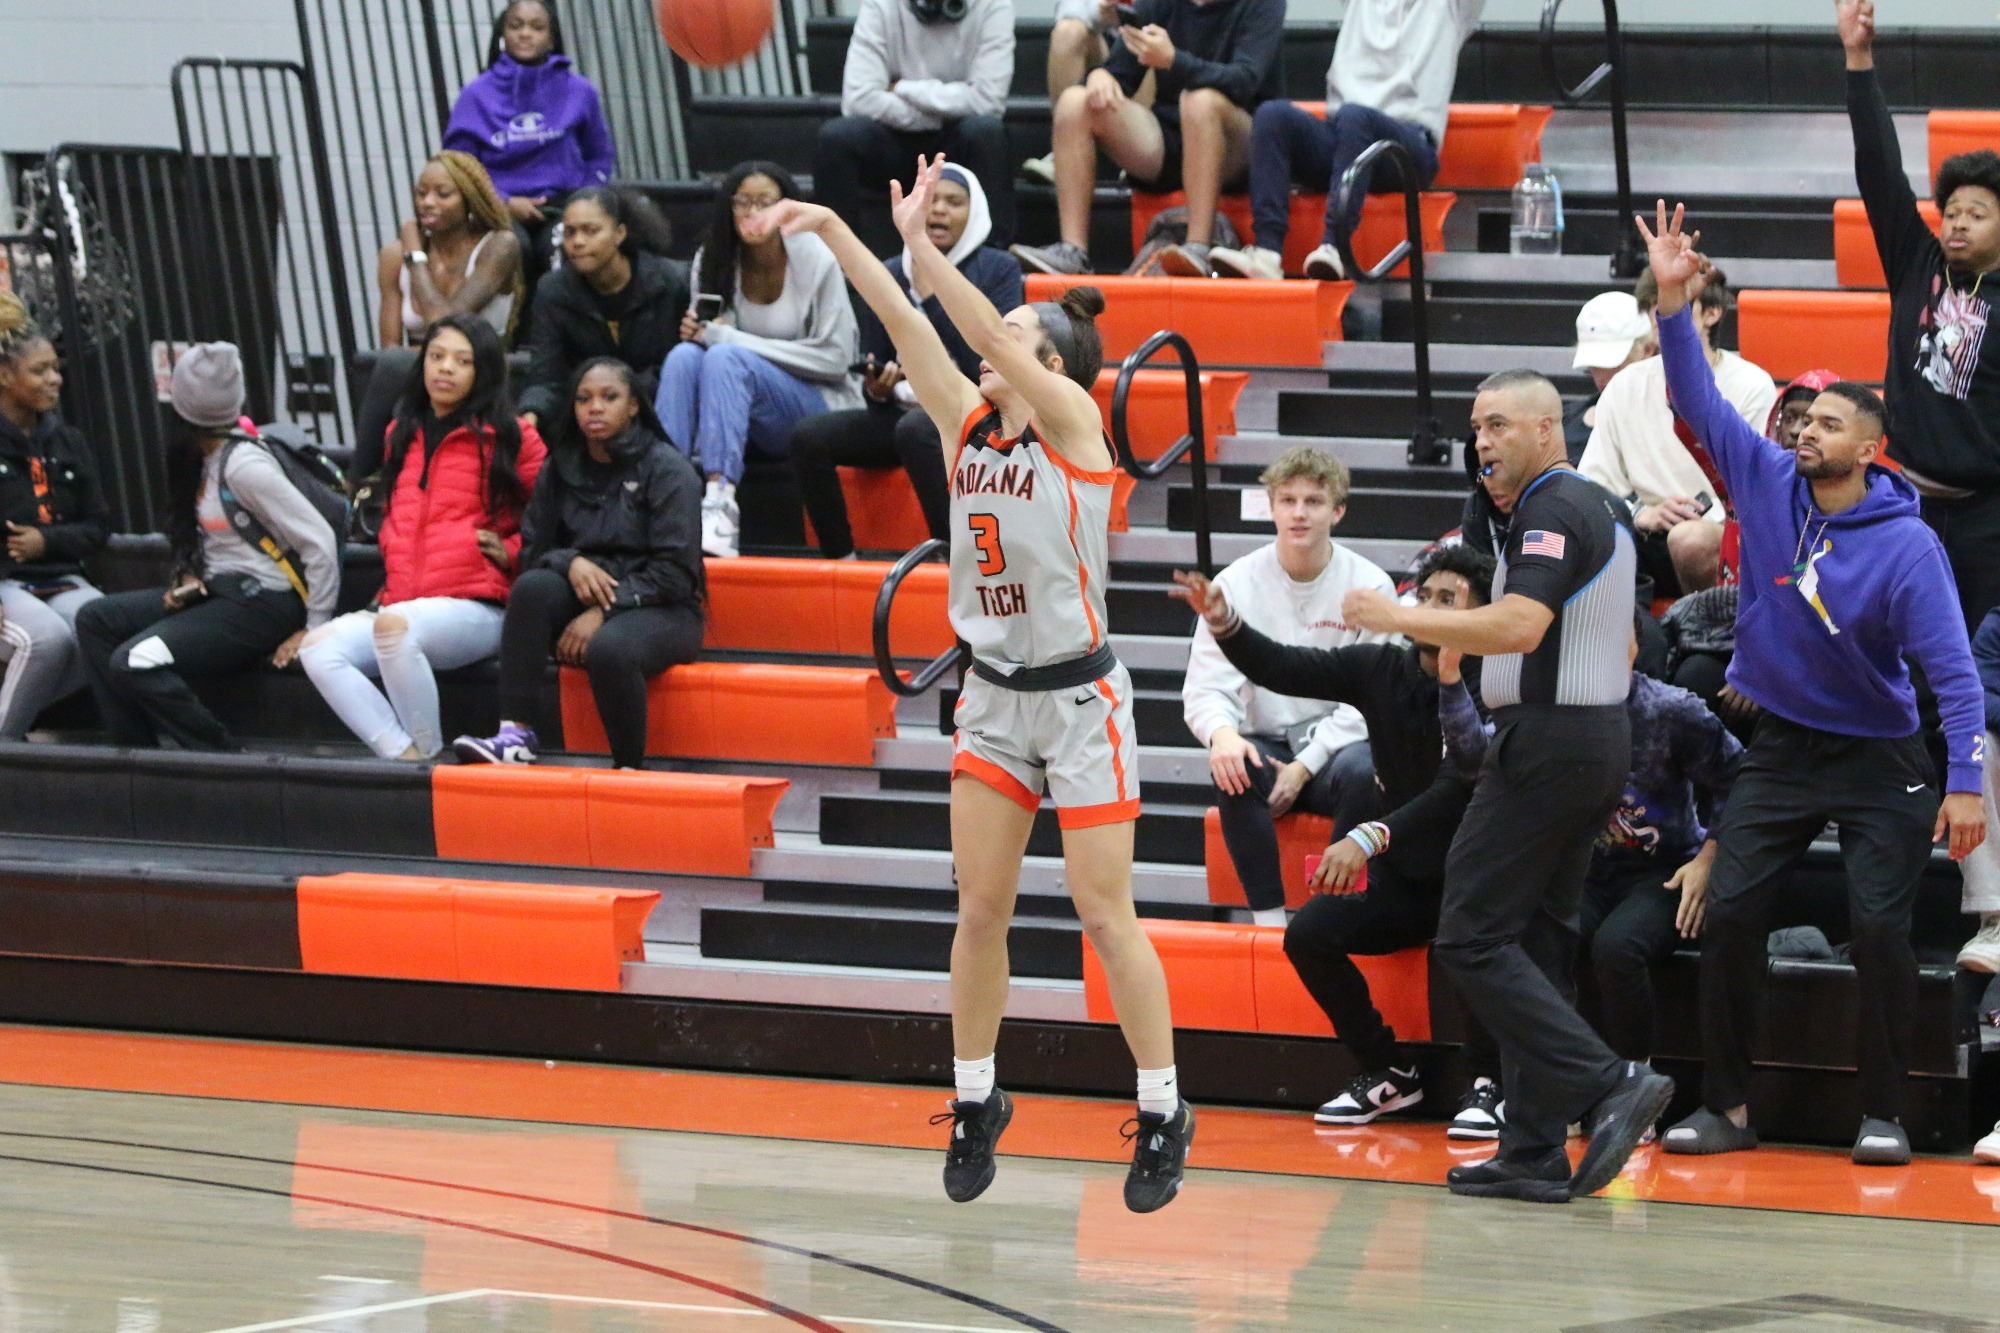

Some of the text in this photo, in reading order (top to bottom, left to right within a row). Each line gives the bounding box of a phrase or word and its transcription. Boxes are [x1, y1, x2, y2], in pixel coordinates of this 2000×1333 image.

[956, 462, 1035, 502] NDIANA
[968, 512, 1007, 577] 3
[1971, 734, 1986, 762] 2
